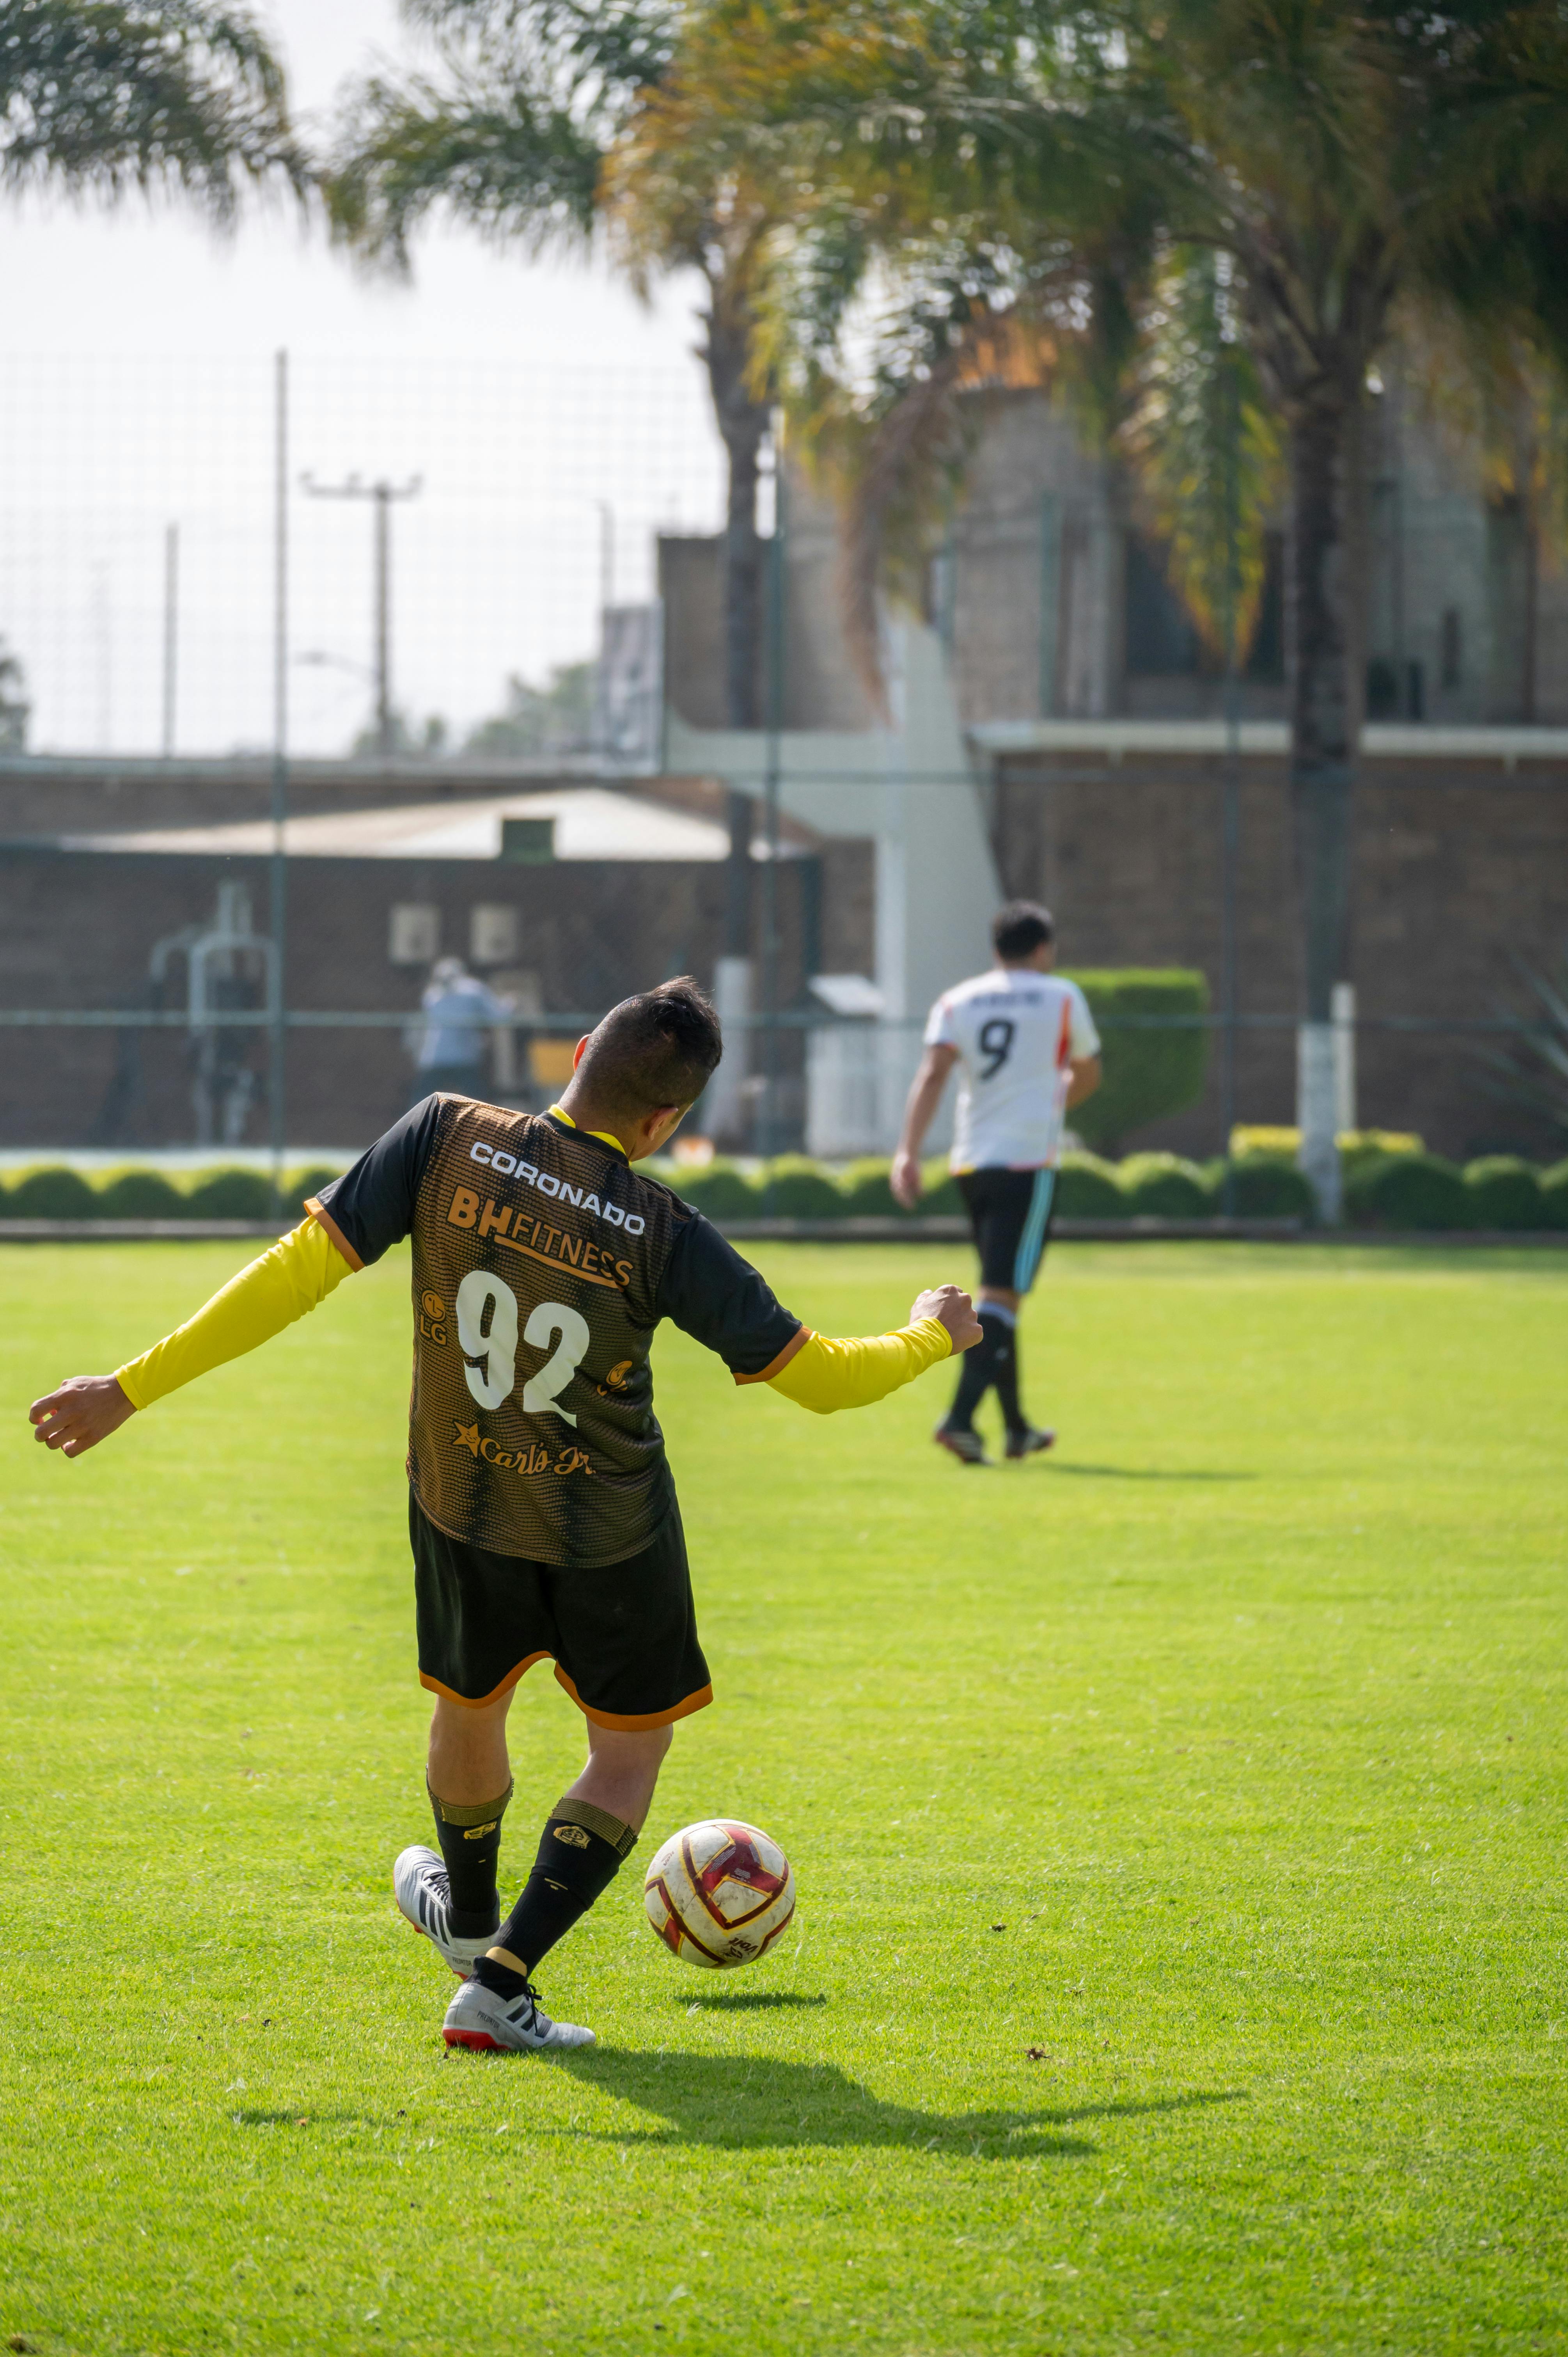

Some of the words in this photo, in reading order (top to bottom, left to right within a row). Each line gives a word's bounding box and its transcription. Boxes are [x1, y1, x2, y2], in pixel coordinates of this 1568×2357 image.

[979, 1019, 1015, 1079] 9
[470, 1142, 645, 1235] CORONADO
[420, 1314, 446, 1345] LG
[456, 1270, 590, 1428] 92
[480, 1438, 553, 1475] Carl's
[452, 1956, 472, 1967] PREDATOR
[477, 2011, 500, 2031] PREDATOR
